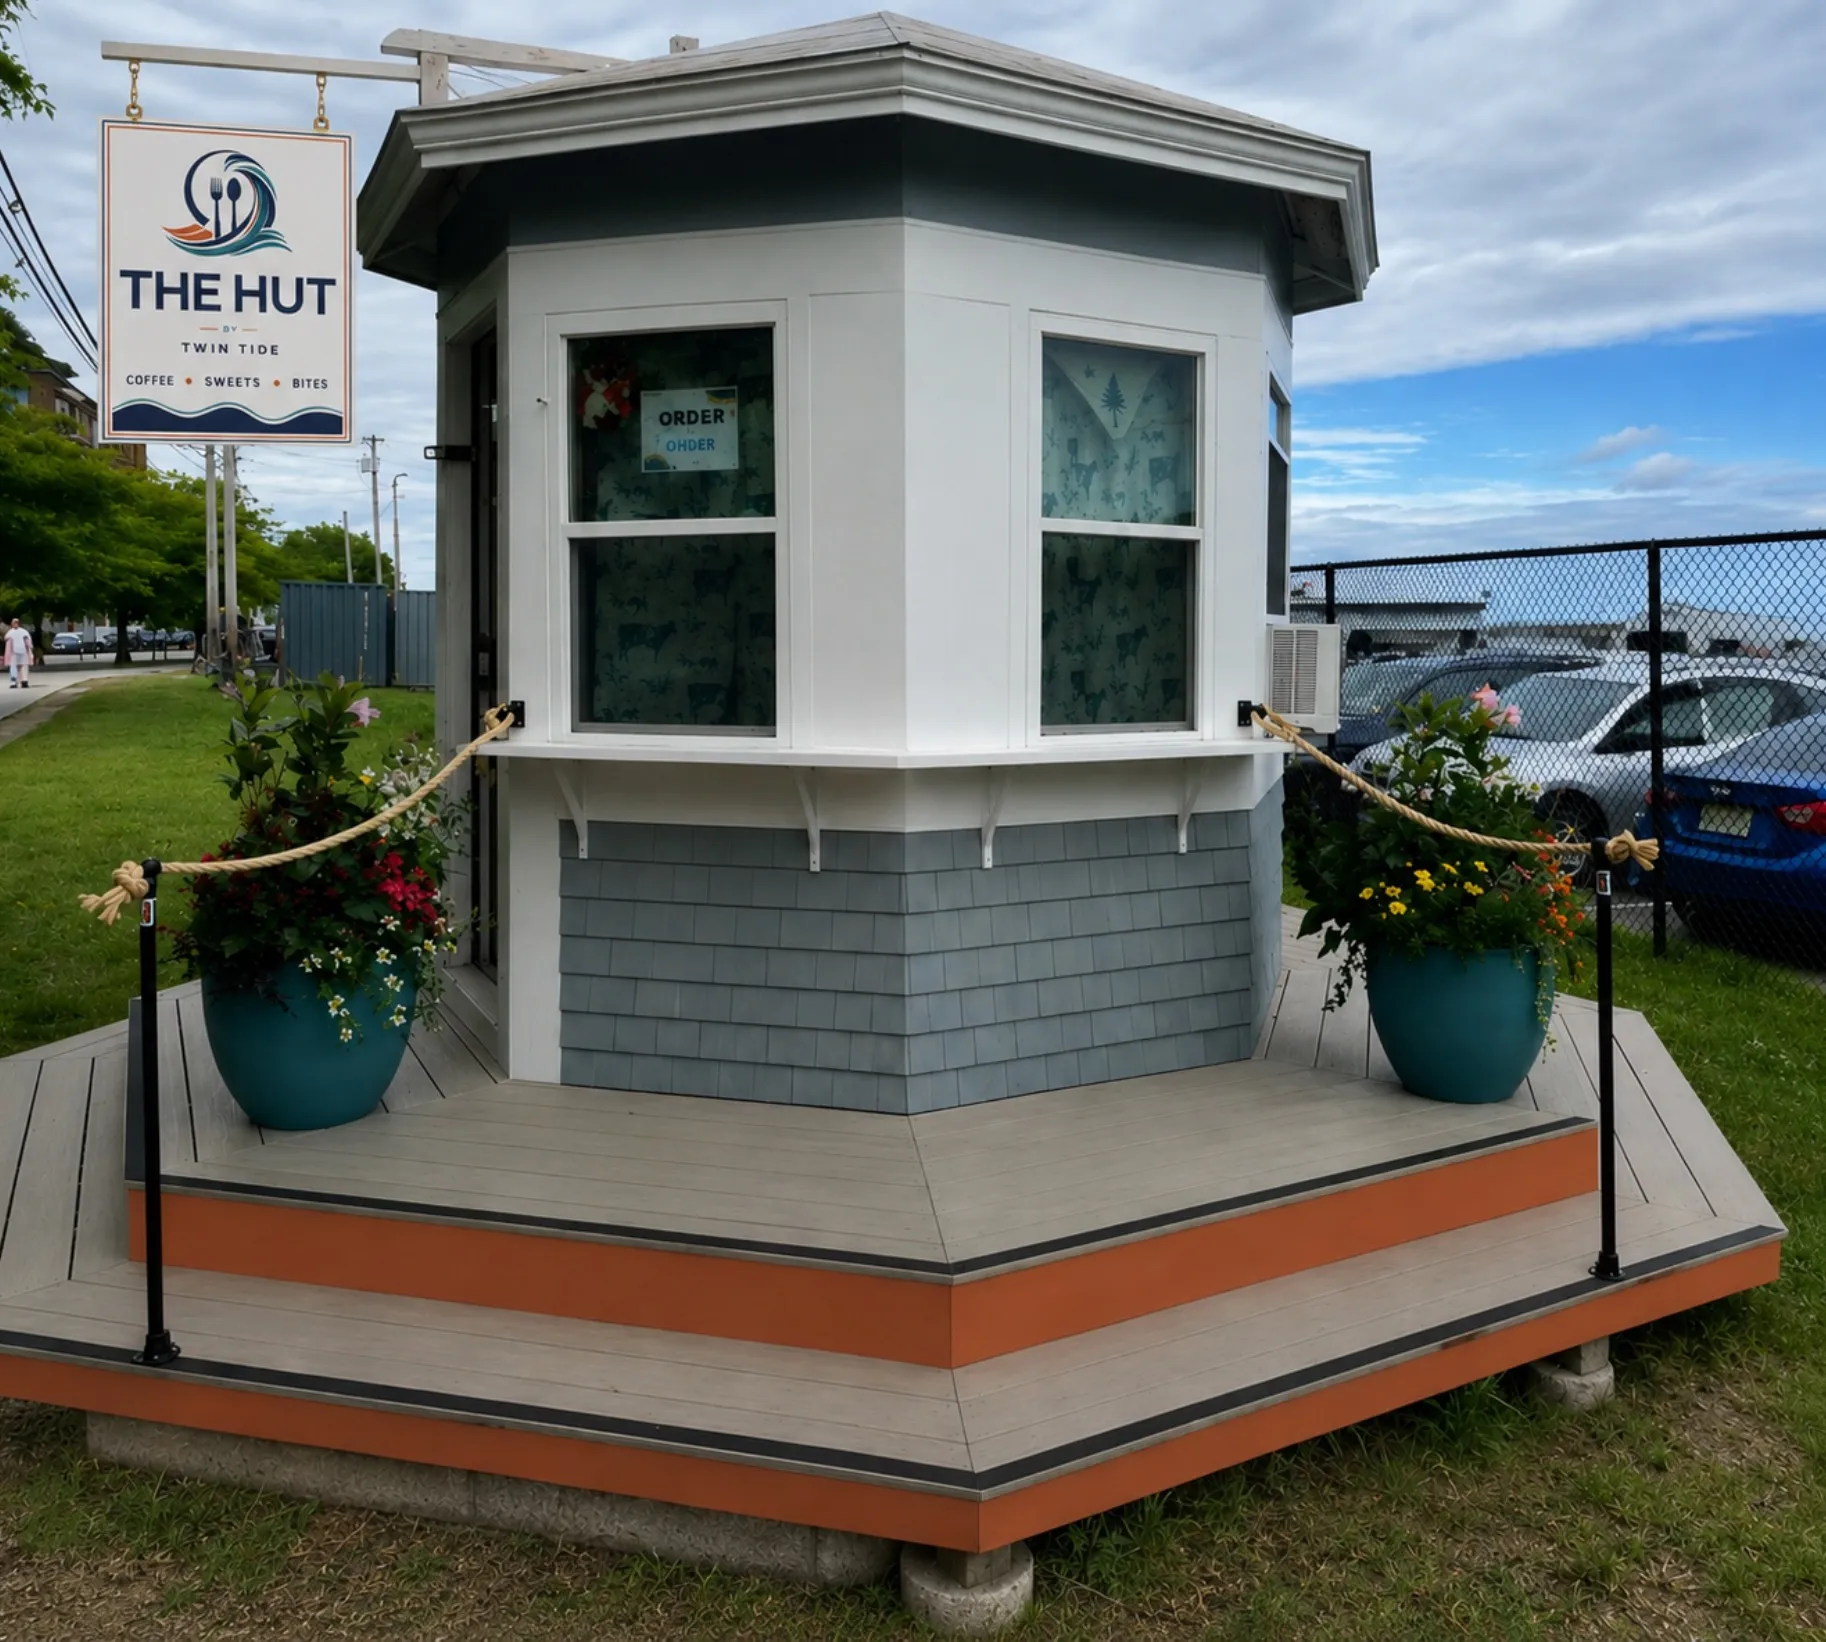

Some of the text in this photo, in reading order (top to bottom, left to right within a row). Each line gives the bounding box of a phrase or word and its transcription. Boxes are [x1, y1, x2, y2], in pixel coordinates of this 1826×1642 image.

[119, 269, 337, 316] THE HUT
[222, 325, 238, 333] BY
[181, 341, 279, 356] TWIN TIDE
[126, 374, 328, 390] COFFEE SWEETS BITES
[659, 408, 725, 426] ORDER
